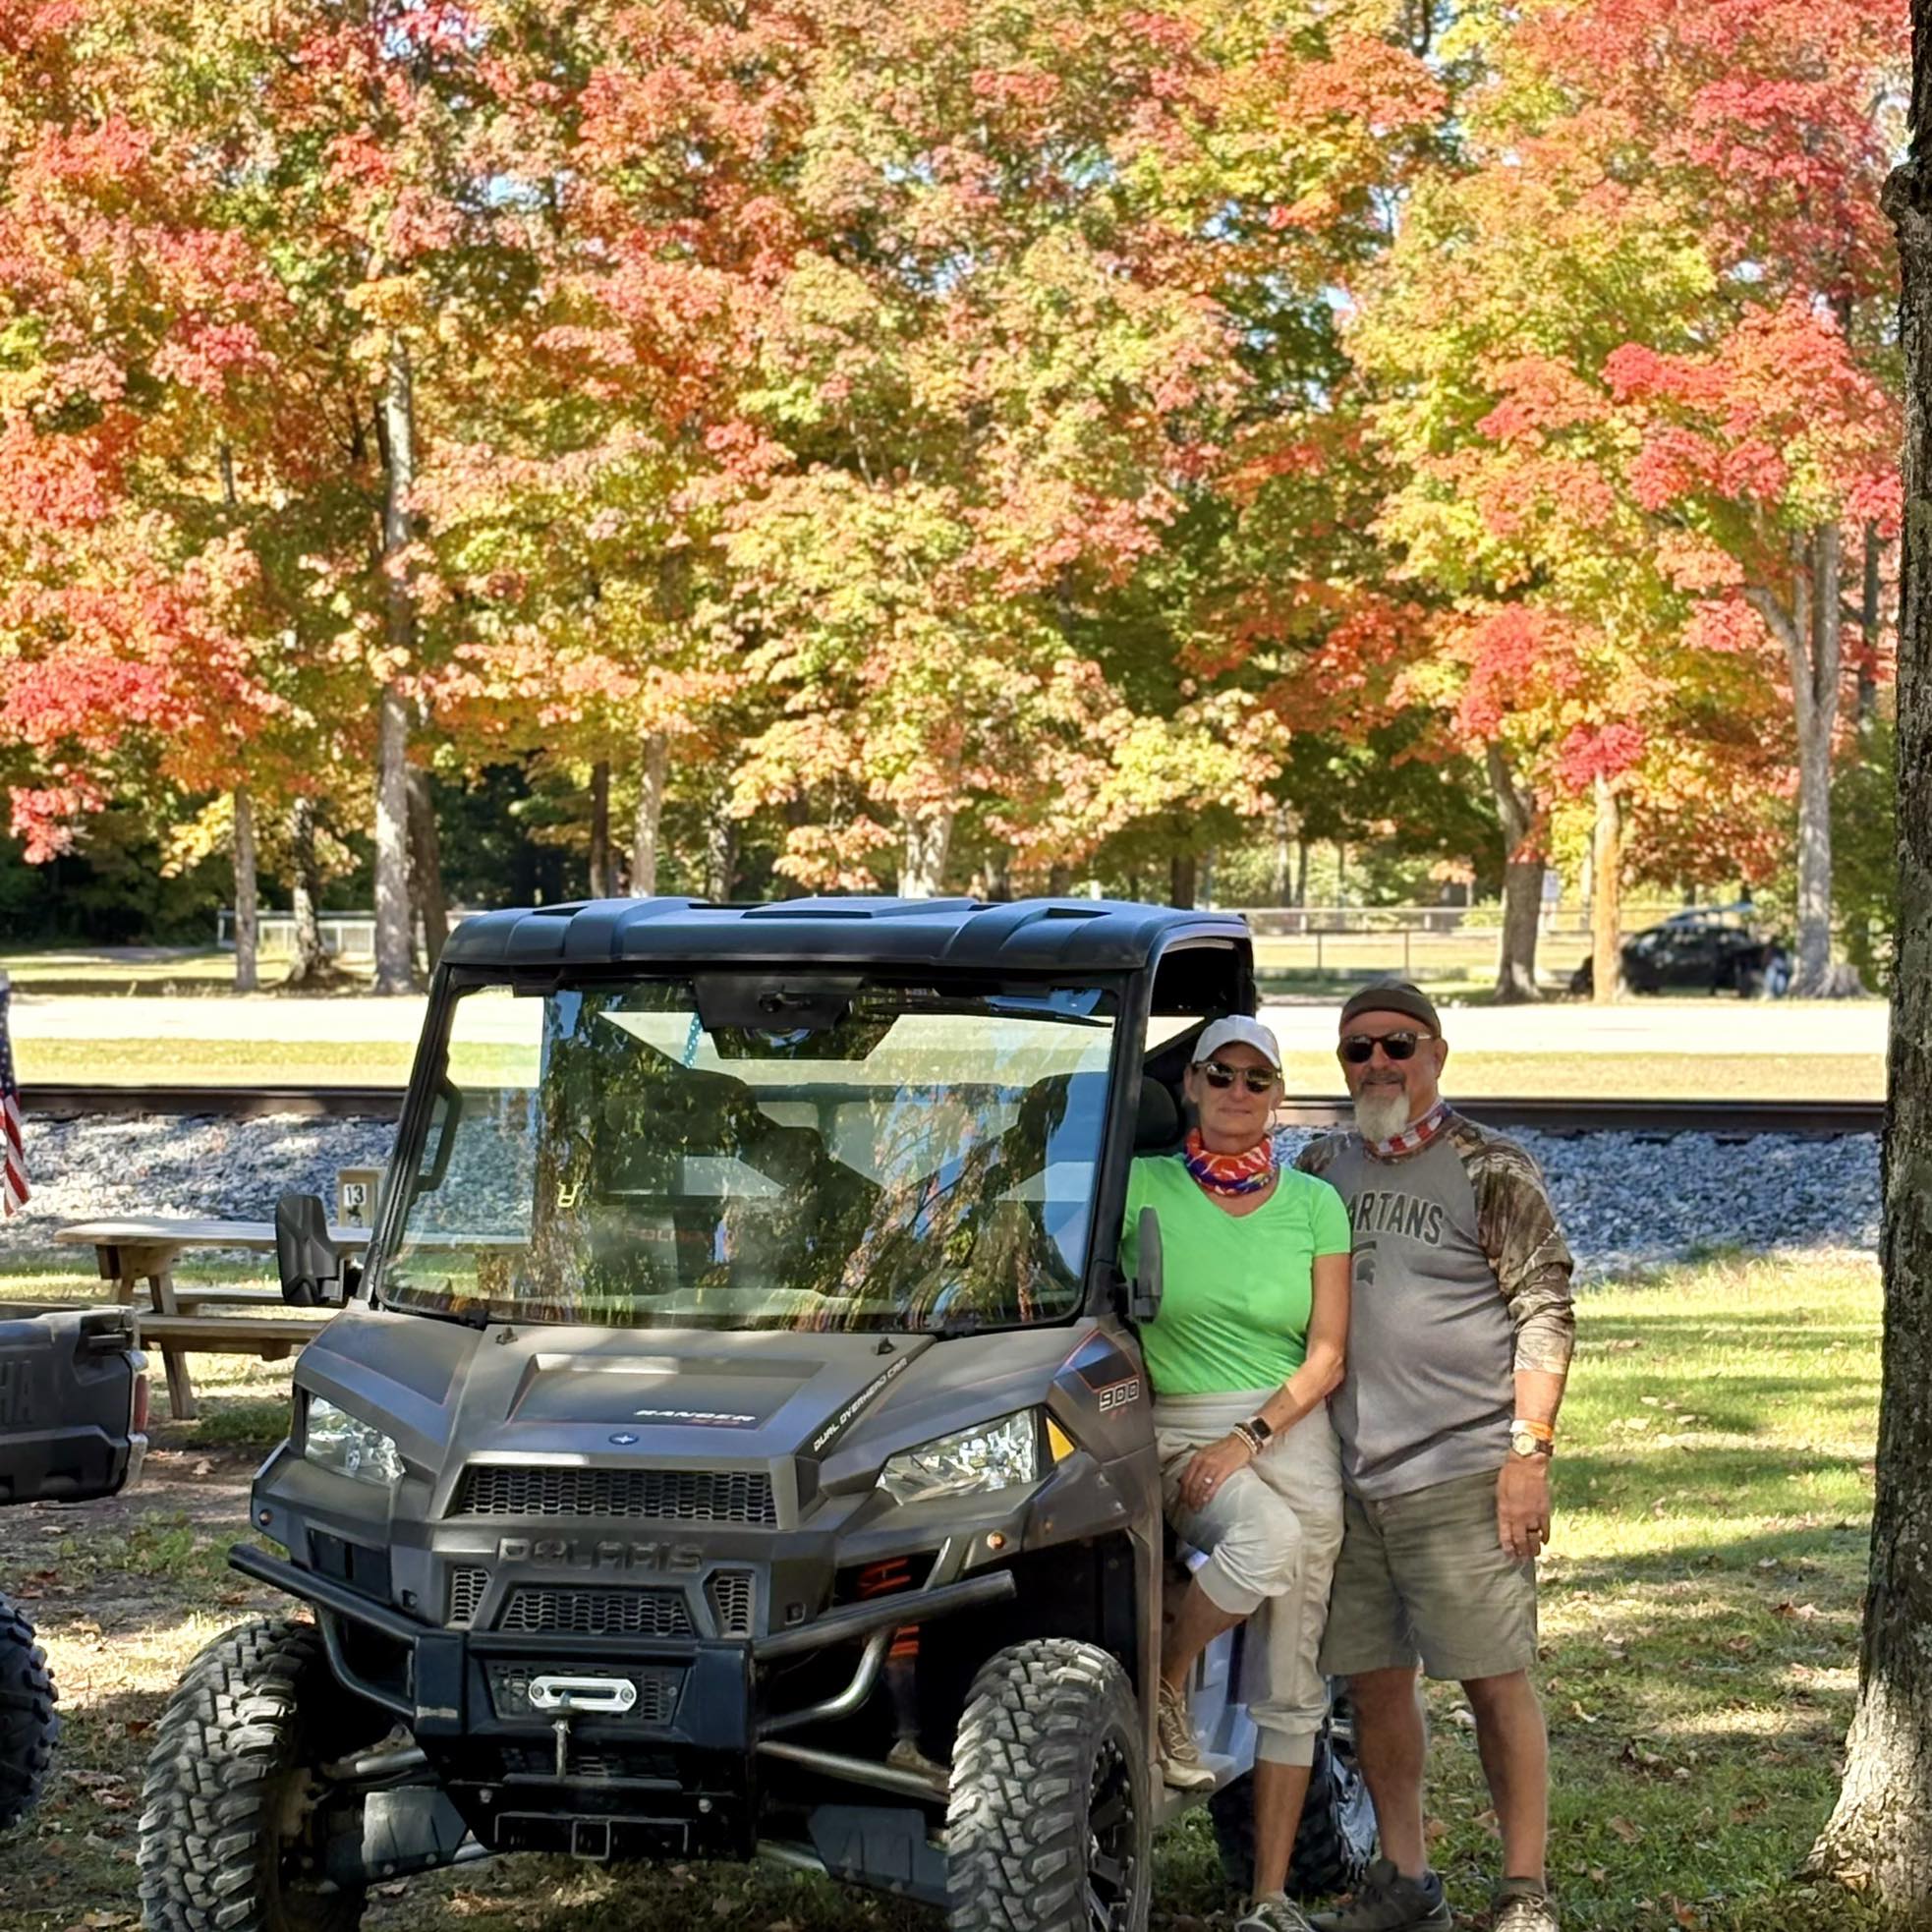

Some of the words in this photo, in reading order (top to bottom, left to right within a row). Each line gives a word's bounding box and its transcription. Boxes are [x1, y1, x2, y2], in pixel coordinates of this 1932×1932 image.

[346, 1185, 365, 1204] 13
[1347, 1190, 1444, 1247] ARTANS
[1099, 1378, 1140, 1412] 900
[814, 1423, 840, 1452] DUAL
[839, 1375, 887, 1425] OVERHEAD
[498, 1538, 704, 1573] POLARIS
